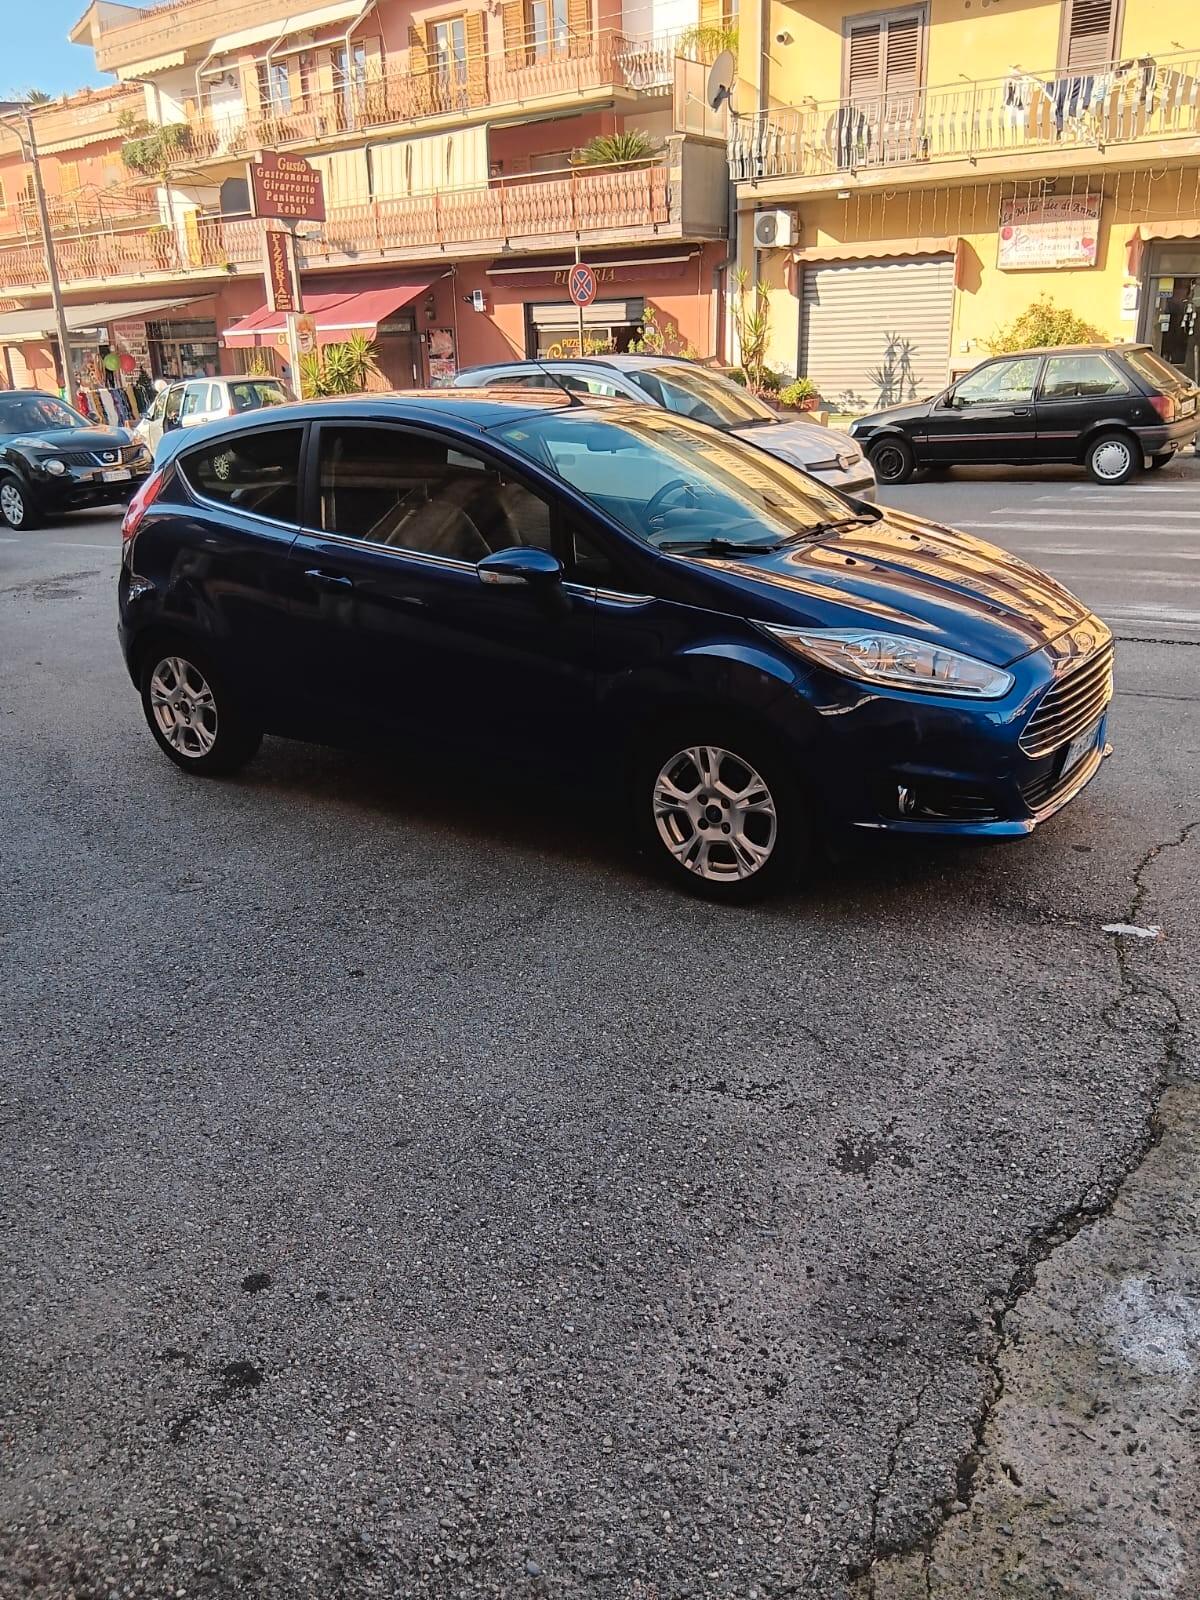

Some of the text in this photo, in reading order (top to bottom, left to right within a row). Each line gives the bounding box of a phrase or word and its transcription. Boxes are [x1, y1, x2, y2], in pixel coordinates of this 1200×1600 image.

[256, 167, 320, 184] Gastronomia
[263, 179, 316, 194] Girarrosto
[265, 190, 315, 205] Panineria
[277, 202, 307, 215] Kebab
[1073, 202, 1097, 218] Anna
[271, 233, 287, 295] PIZZERIA
